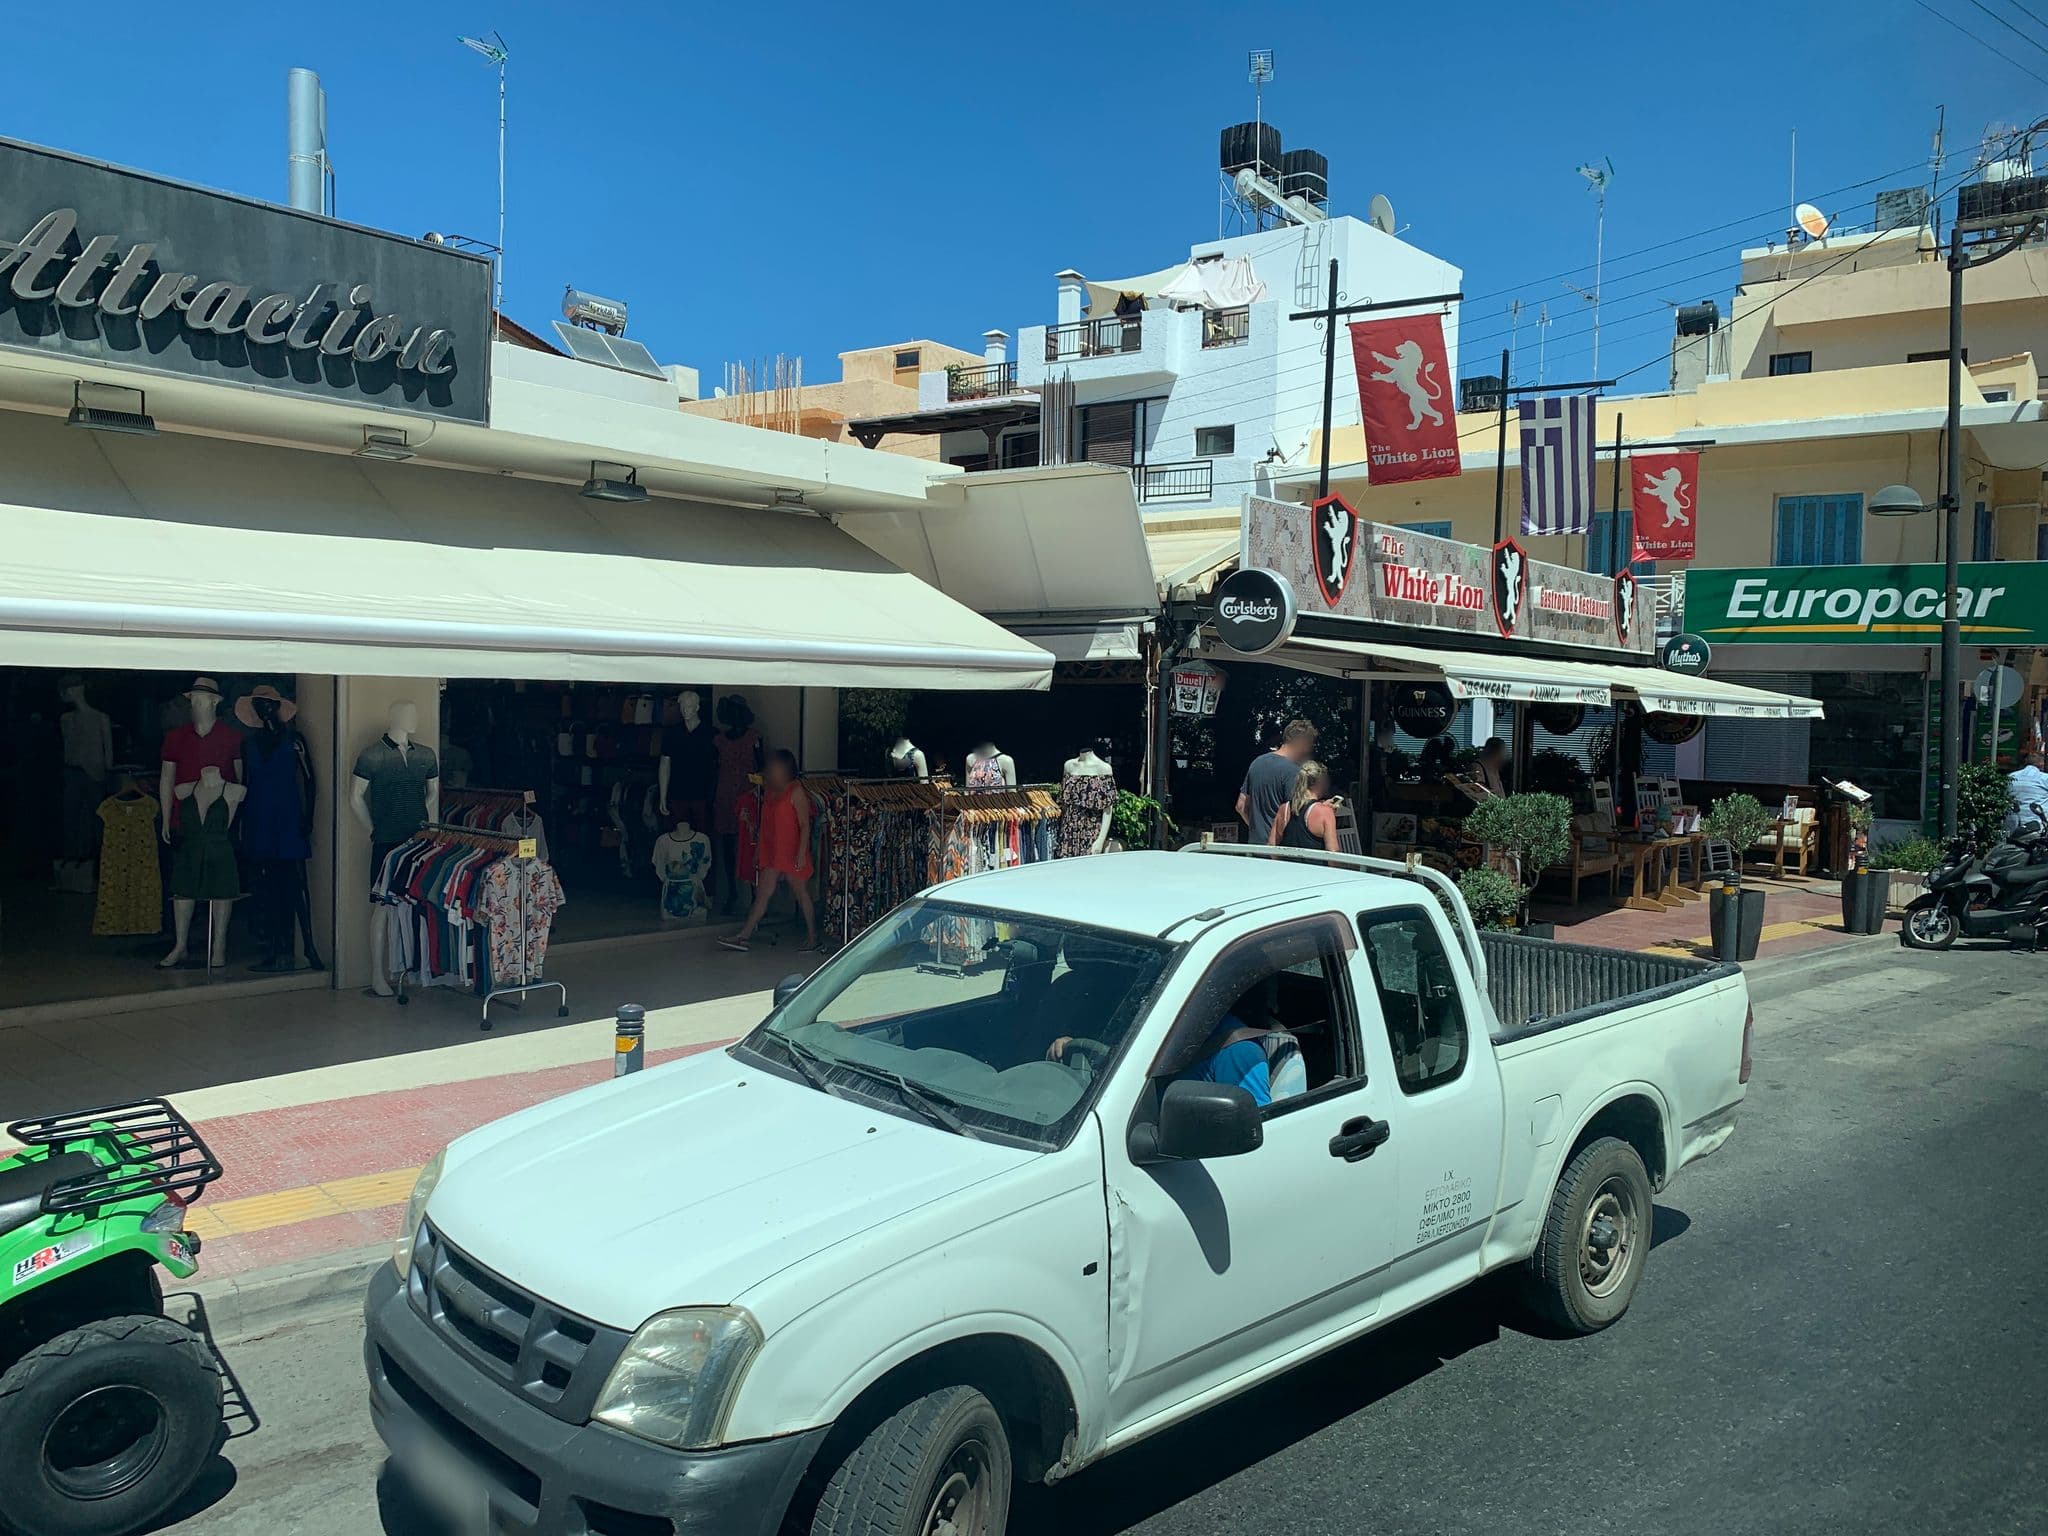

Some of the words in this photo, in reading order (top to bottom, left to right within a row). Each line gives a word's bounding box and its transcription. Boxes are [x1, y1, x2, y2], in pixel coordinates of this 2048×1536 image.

[1, 208, 456, 374] Attraction
[1371, 444, 1391, 453] The
[1372, 452, 1418, 466] White
[1421, 448, 1455, 460] Lion
[1382, 535, 1405, 556] The
[1636, 541, 1668, 549] White
[1670, 539, 1694, 549] Lion
[1382, 563, 1439, 604] White
[1444, 574, 1484, 611] Lion
[1219, 596, 1279, 622] Carlsberg
[1541, 587, 1573, 612] Gastropub
[1579, 594, 1610, 618] Restaurant
[1726, 578, 2005, 626] Europcar
[1668, 649, 1702, 667] Mythos
[1176, 673, 1203, 687] Duvel
[1534, 685, 1561, 701] LUNCH
[1398, 705, 1447, 719] GUINNESS
[1658, 699, 1672, 710] THE
[1676, 700, 1697, 713] WHITE
[1701, 701, 1716, 713] LION
[1452, 1190, 1471, 1206] 2800
[1457, 1202, 1472, 1217] 1110
